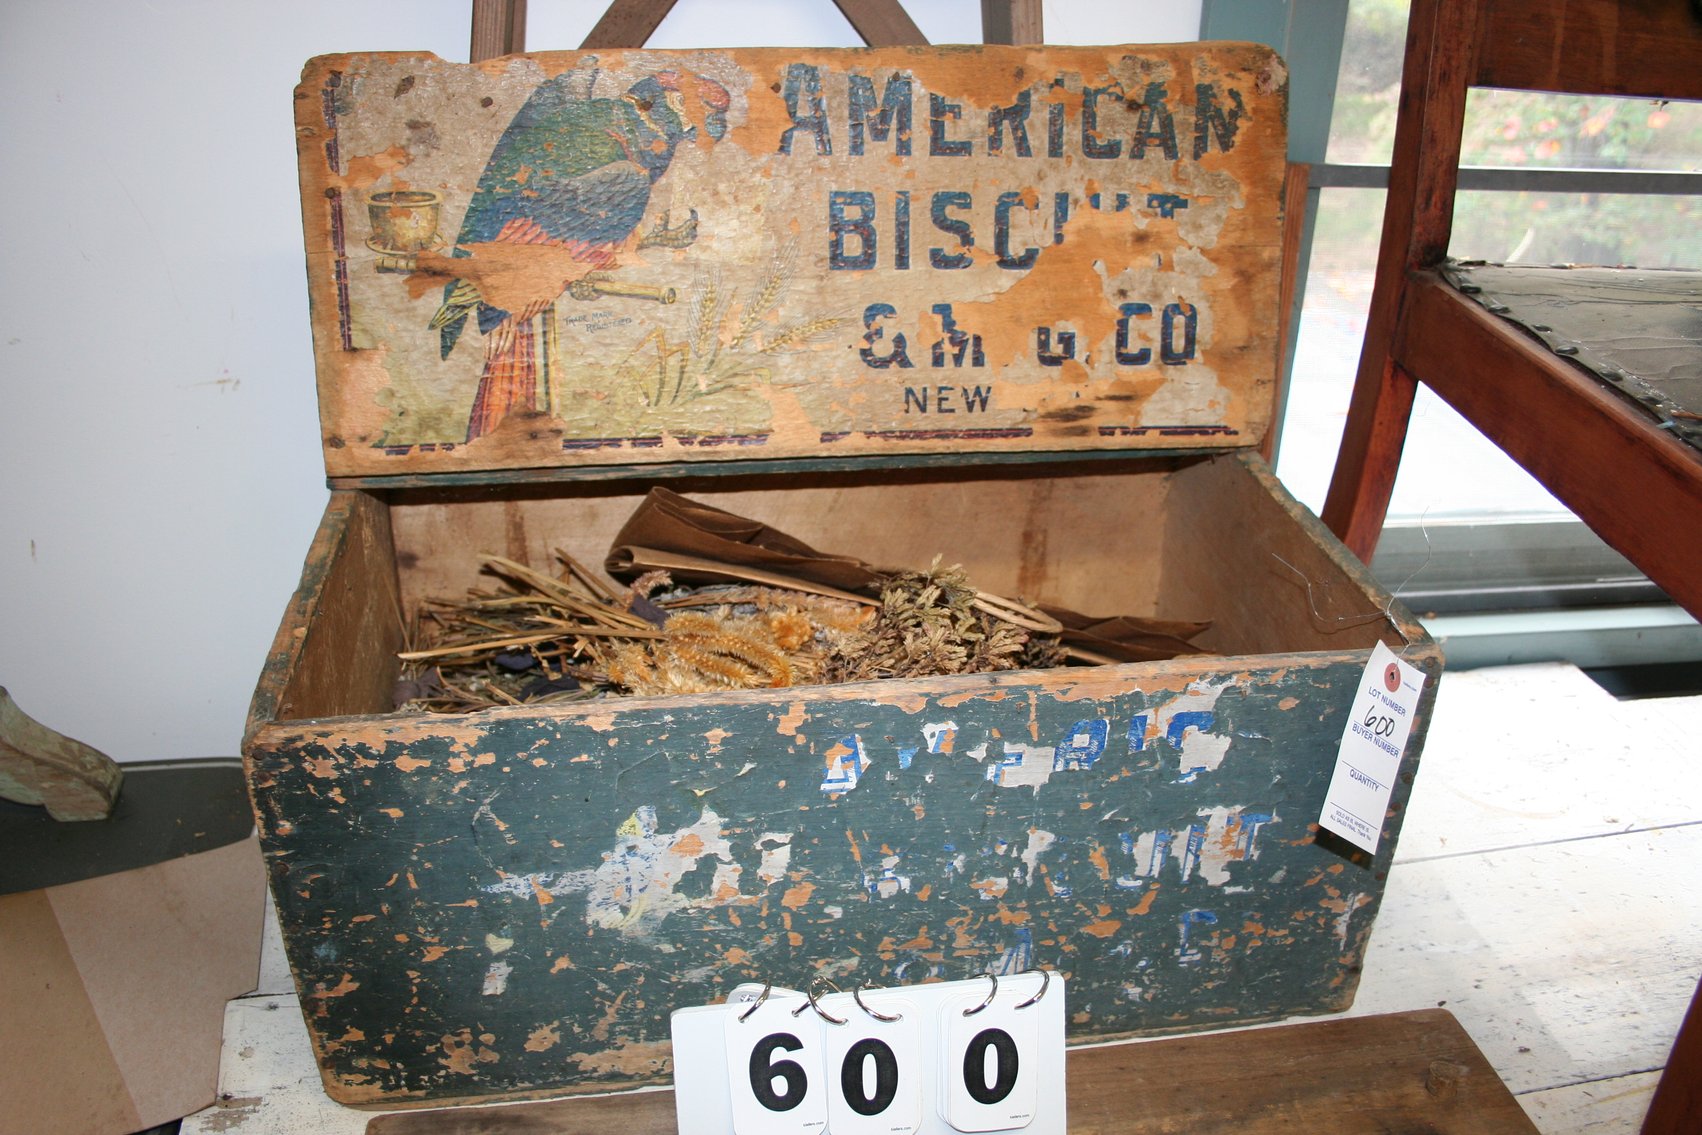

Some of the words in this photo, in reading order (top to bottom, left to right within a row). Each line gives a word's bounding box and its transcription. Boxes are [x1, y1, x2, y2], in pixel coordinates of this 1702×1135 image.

[778, 63, 1244, 161] AMERICAN
[859, 303, 914, 369] &
[1115, 302, 1199, 367] CO
[903, 385, 992, 414] NEW
[1368, 686, 1382, 699] LOT
[1380, 694, 1406, 717] NUMBER
[1364, 705, 1395, 737] 600
[1352, 723, 1374, 741] BUYER
[1373, 736, 1399, 758] NUMBER
[1350, 769, 1379, 792] QUANTITY
